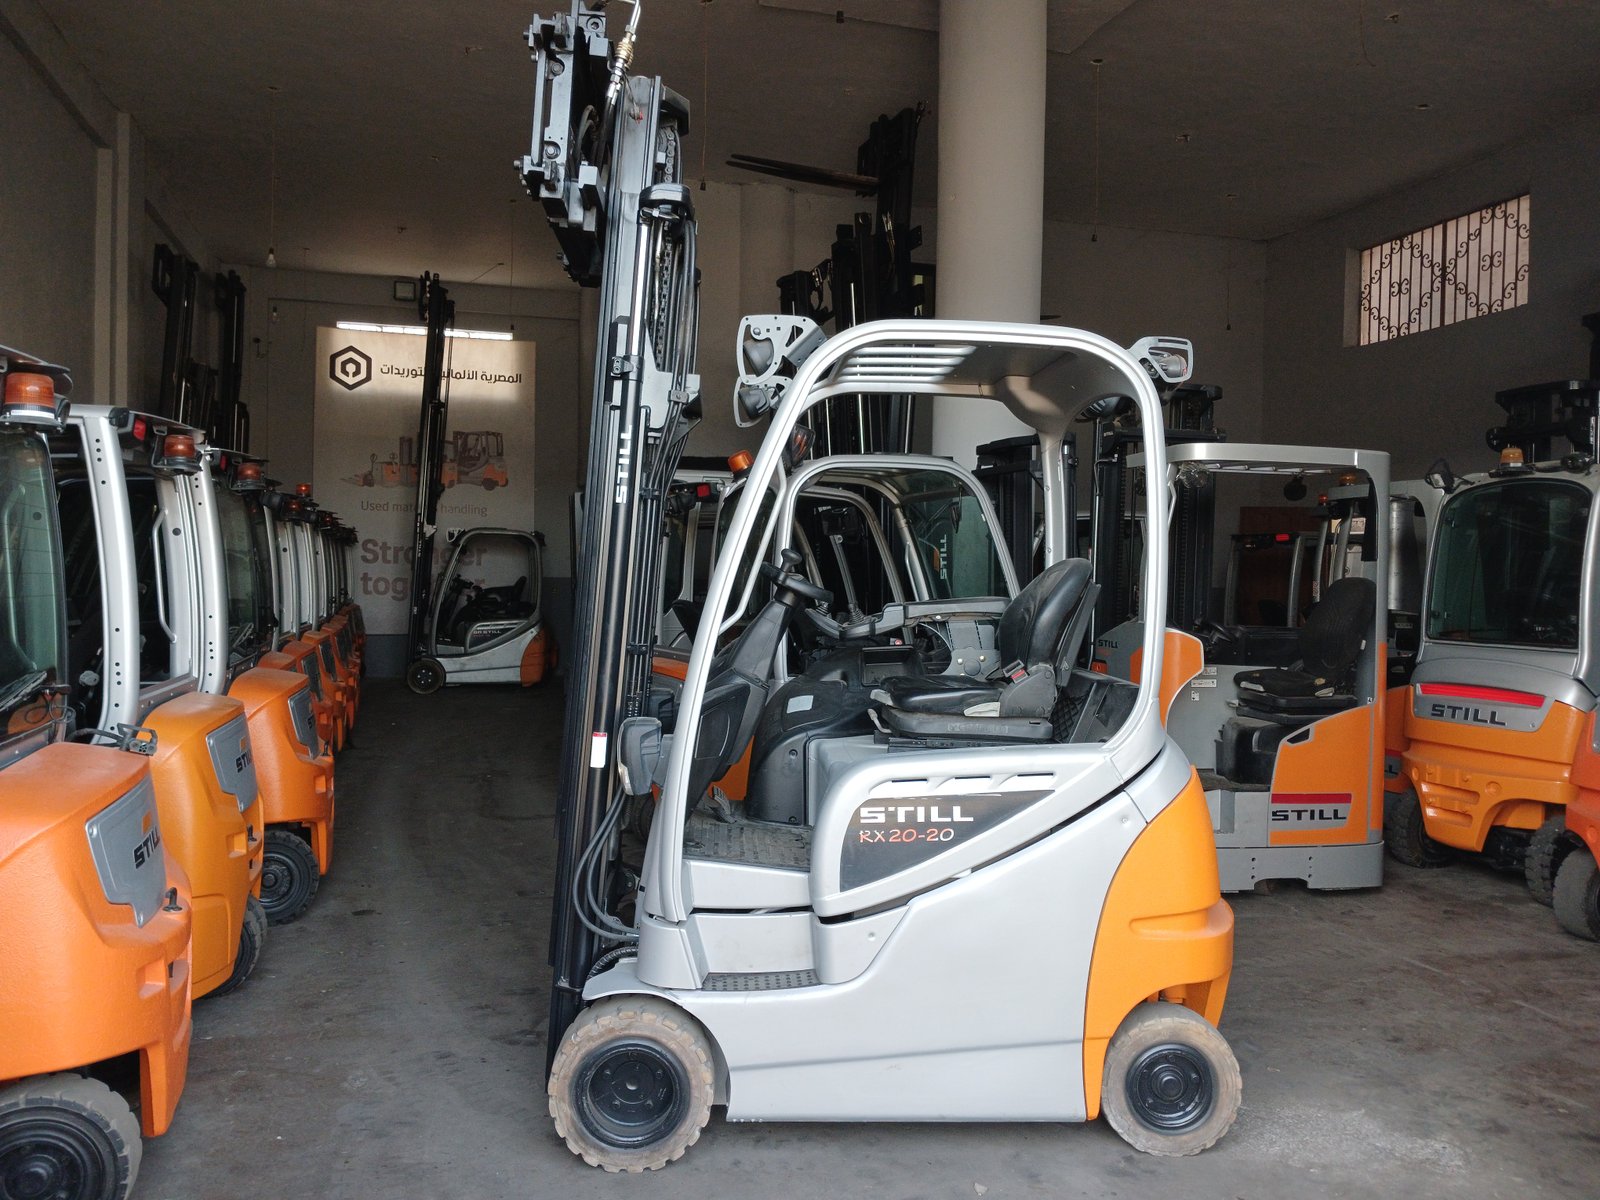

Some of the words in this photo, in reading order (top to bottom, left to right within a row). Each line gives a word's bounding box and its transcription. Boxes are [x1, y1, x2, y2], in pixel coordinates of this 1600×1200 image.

[480, 371, 522, 384] المصرية
[615, 424, 633, 504] STILL
[361, 500, 389, 512] Used
[440, 503, 488, 518] handling
[939, 534, 947, 580] STILL
[1098, 639, 1119, 649] STILL
[1431, 703, 1506, 726] STILL
[859, 806, 974, 824] STILL
[1271, 808, 1348, 821] STILL
[859, 829, 886, 843] RX
[888, 828, 955, 843] 20-20
